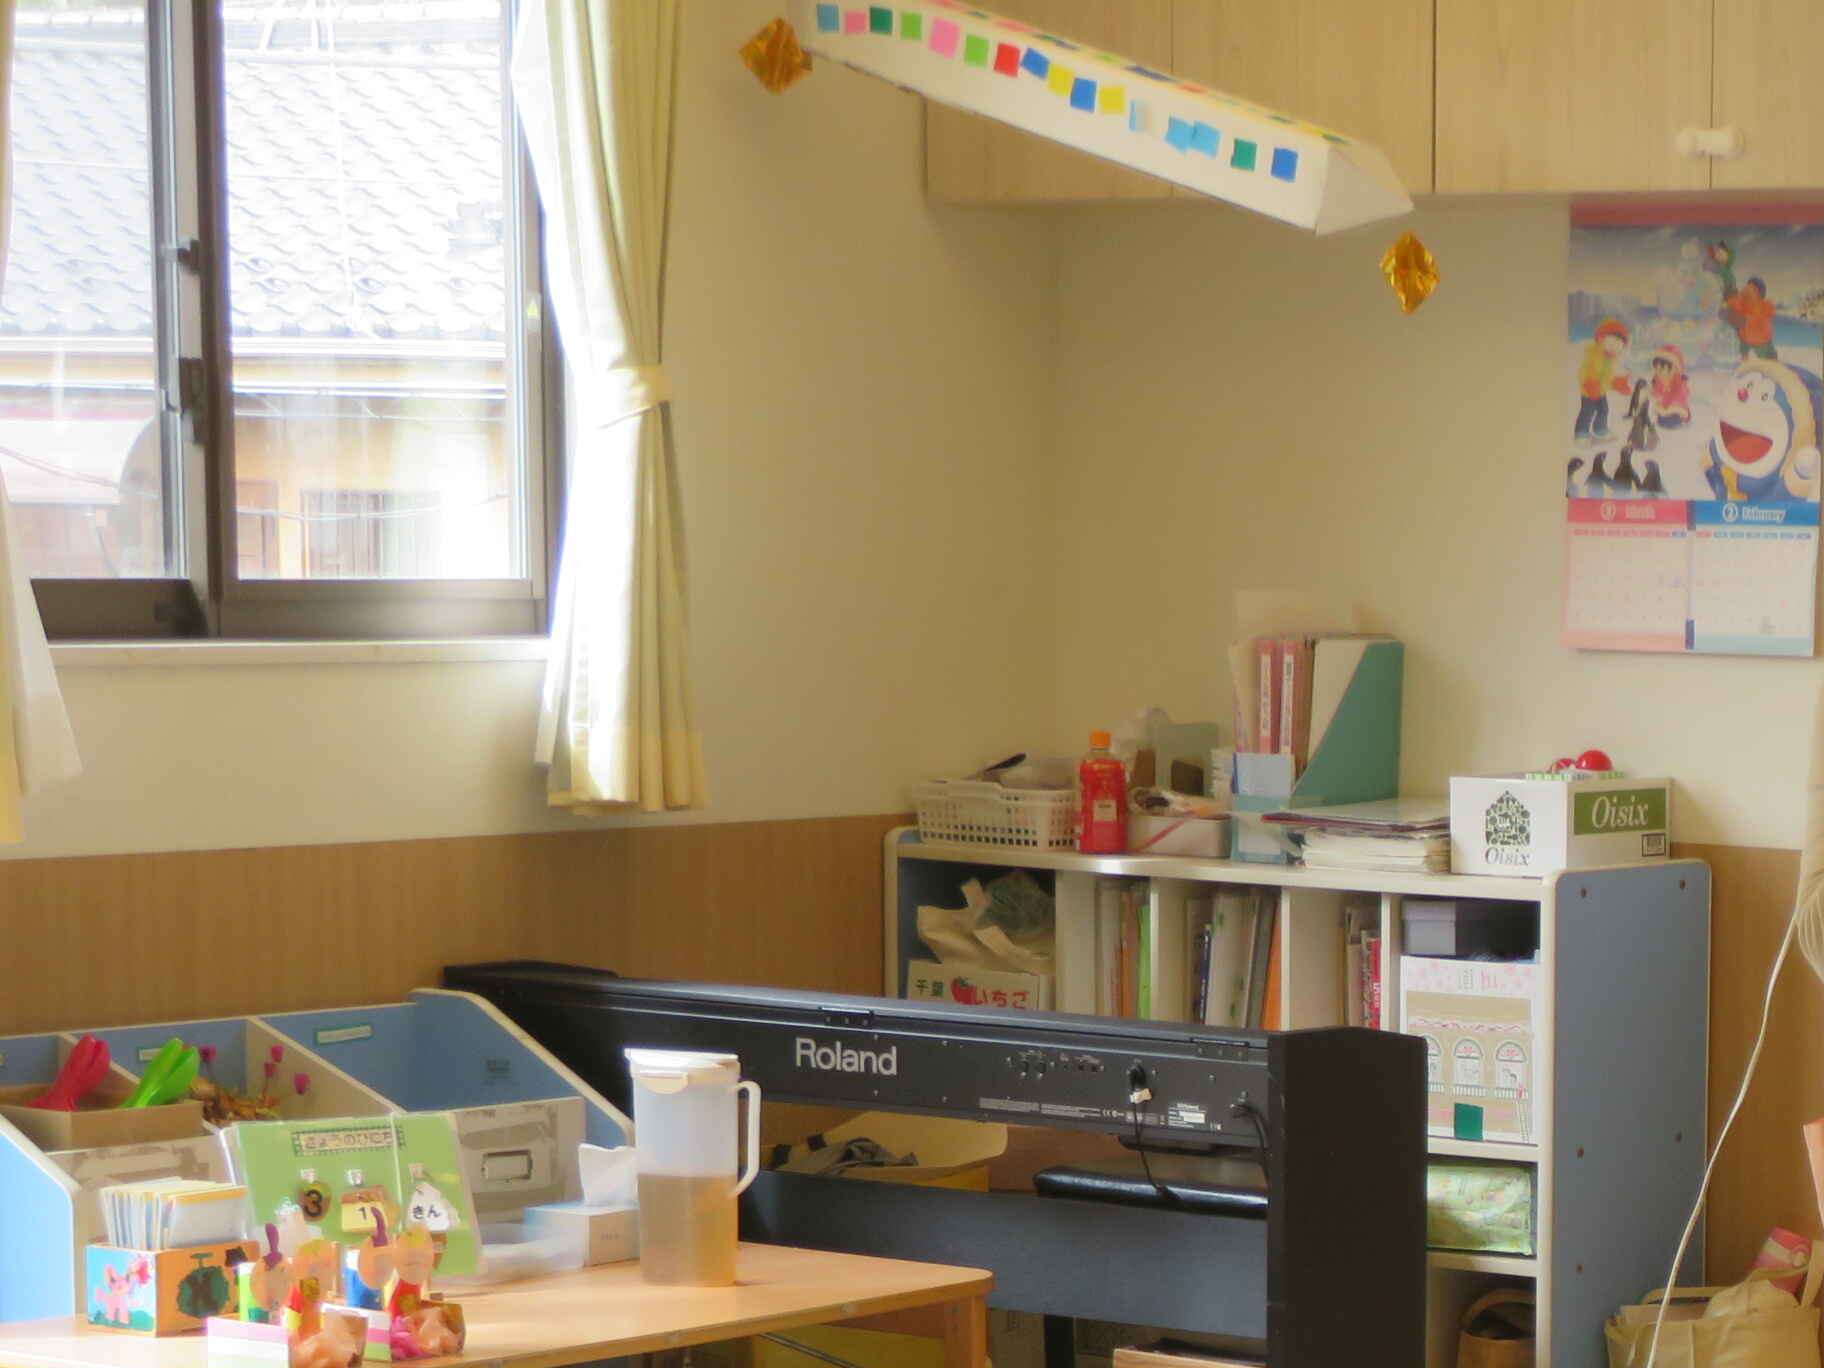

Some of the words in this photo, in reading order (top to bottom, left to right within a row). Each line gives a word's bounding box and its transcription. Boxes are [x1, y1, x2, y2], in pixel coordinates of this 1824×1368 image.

[1591, 796, 1649, 828] Oisix
[1485, 847, 1530, 866] Oisix
[795, 1037, 897, 1075] Roland
[304, 1190, 323, 1217] 3
[412, 1205, 441, 1220] きん
